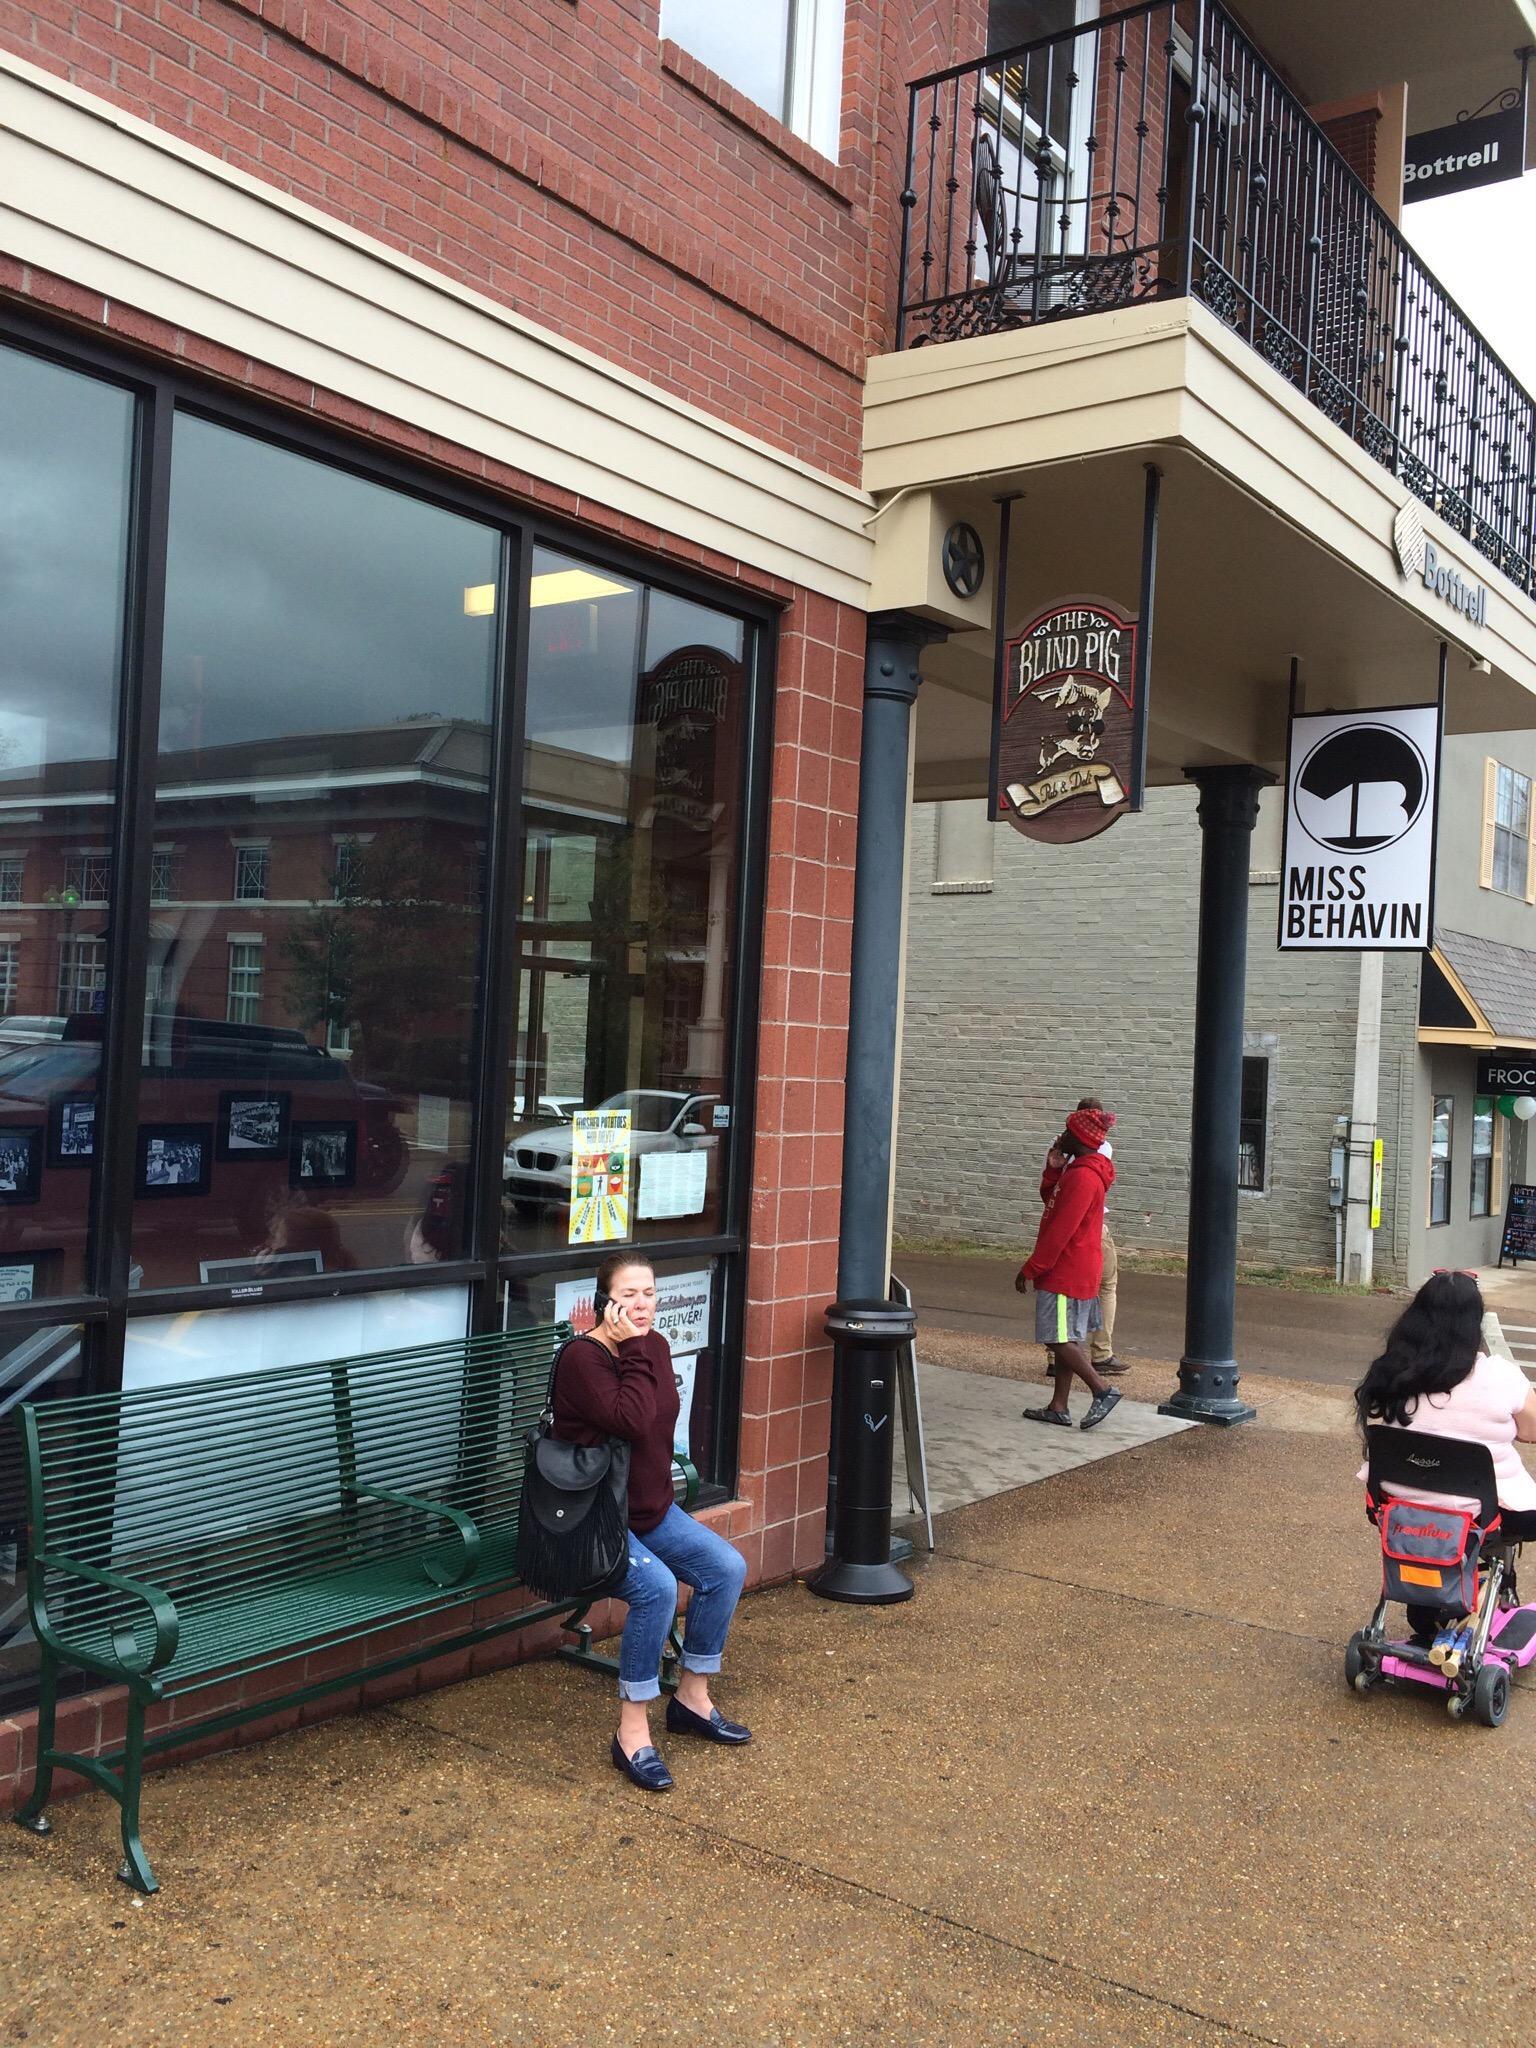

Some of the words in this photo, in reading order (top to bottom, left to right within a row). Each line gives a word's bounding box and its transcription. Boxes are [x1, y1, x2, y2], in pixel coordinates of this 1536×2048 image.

[1402, 141, 1499, 184] Bottrell
[1424, 542, 1488, 627] Bottrell
[1055, 612, 1089, 632] THE
[1018, 635, 1080, 694] BLIND
[1085, 629, 1121, 683] PIG
[1040, 782, 1058, 803] Pub
[1060, 781, 1067, 794] &
[1070, 770, 1092, 789] Deli
[1289, 865, 1367, 901] MISS
[1287, 903, 1422, 939] BEHAVIN
[1488, 1068, 1536, 1085] FROC
[659, 1310, 702, 1329] DELIVER!
